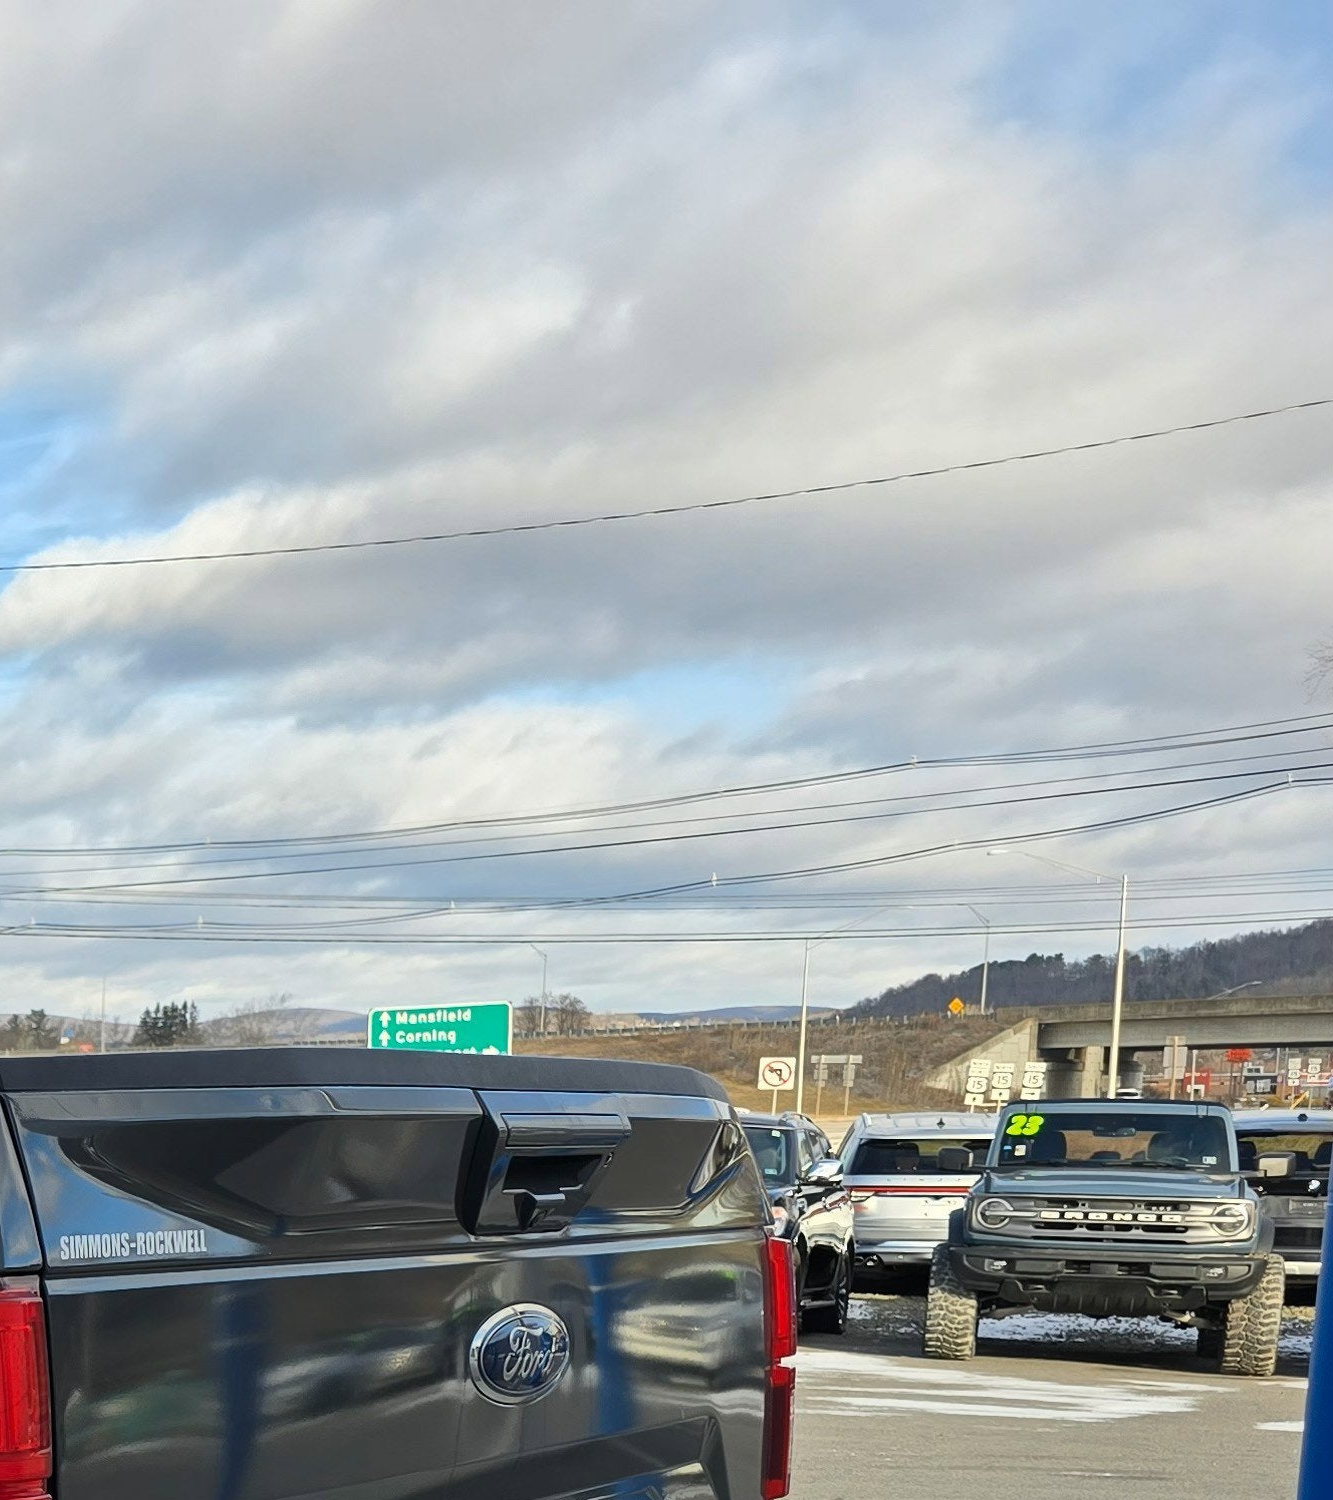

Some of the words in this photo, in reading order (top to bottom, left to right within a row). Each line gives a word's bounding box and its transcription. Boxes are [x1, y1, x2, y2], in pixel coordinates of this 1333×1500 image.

[395, 1008, 472, 1024] Mansfield
[395, 1029, 457, 1045] Corning
[972, 1080, 983, 1090] 15
[997, 1076, 1009, 1085] 15
[1028, 1076, 1039, 1085] 15
[1006, 1114, 1044, 1135] 23
[1039, 1210, 1183, 1223] BRONCO
[60, 1229, 207, 1260] SIMMONS-ROCKWELL
[503, 1326, 556, 1382] Ford
